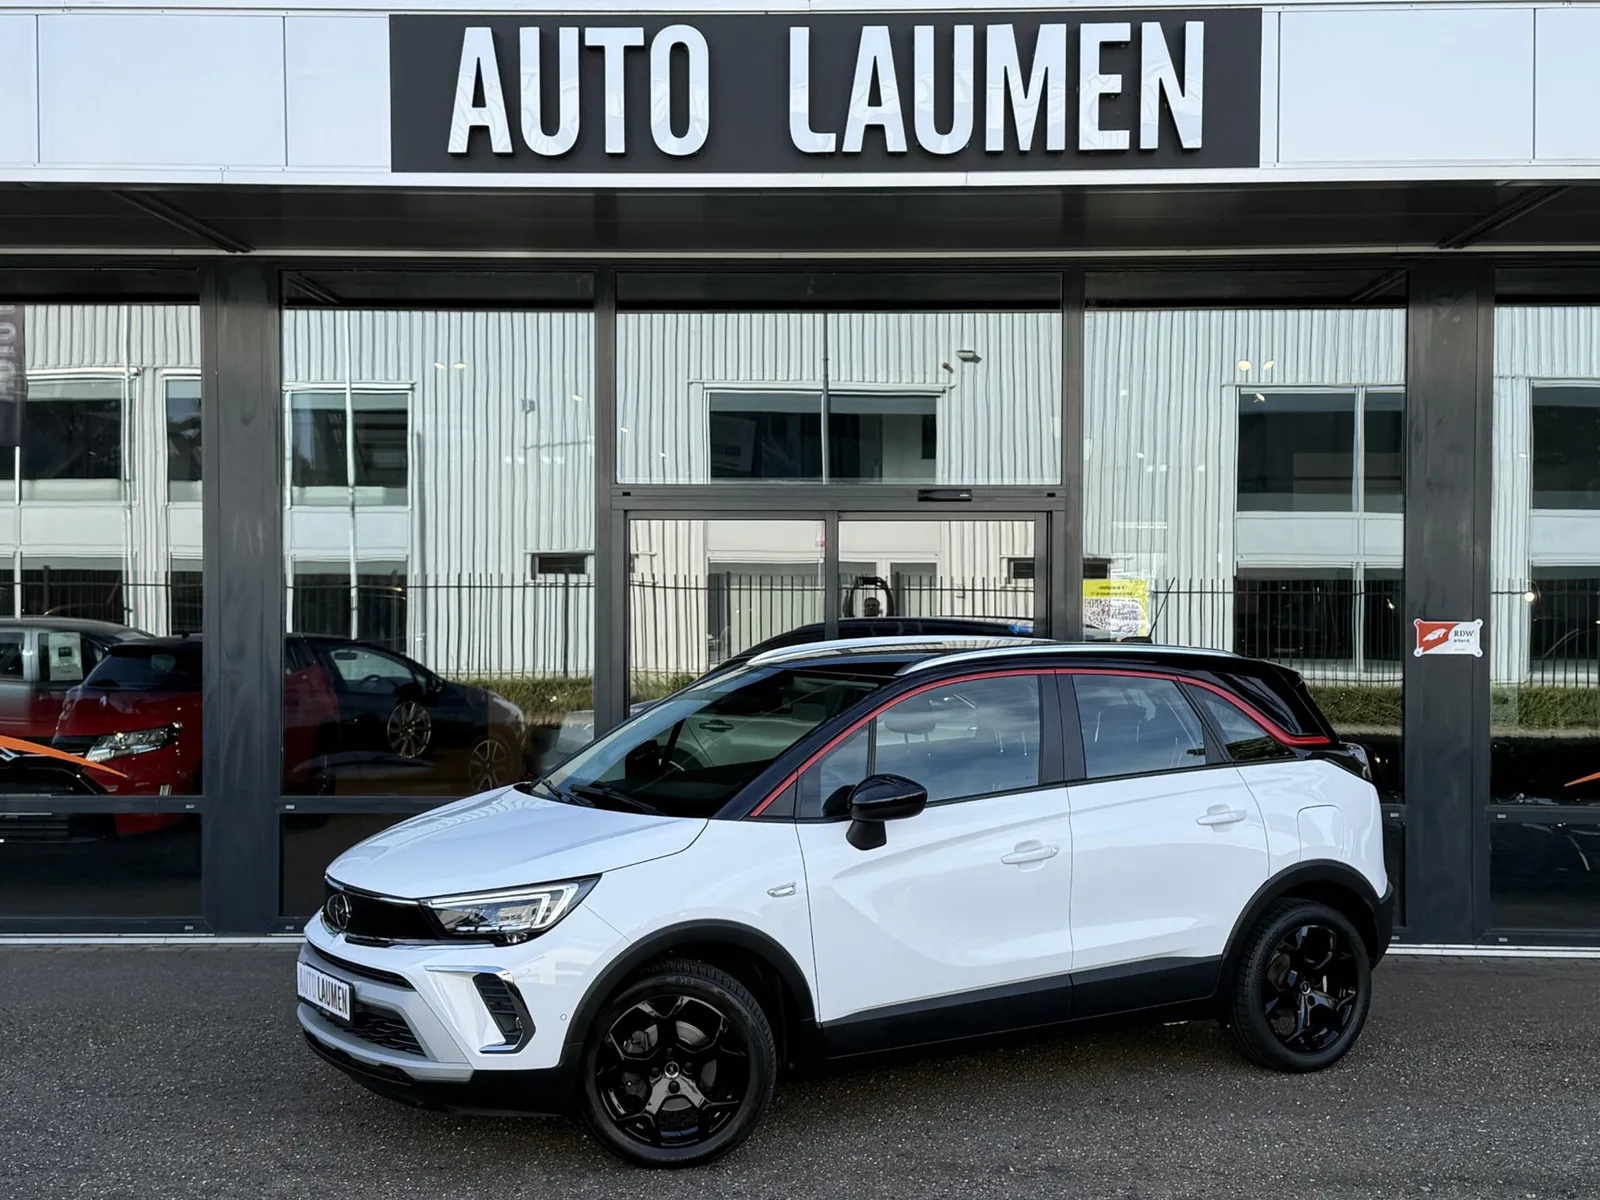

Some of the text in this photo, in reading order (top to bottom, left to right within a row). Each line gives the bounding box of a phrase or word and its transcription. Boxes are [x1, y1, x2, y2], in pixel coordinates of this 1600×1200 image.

[447, 21, 1205, 156] AUTO LAUMEN
[300, 967, 348, 1015] AUTO LAUMEN
